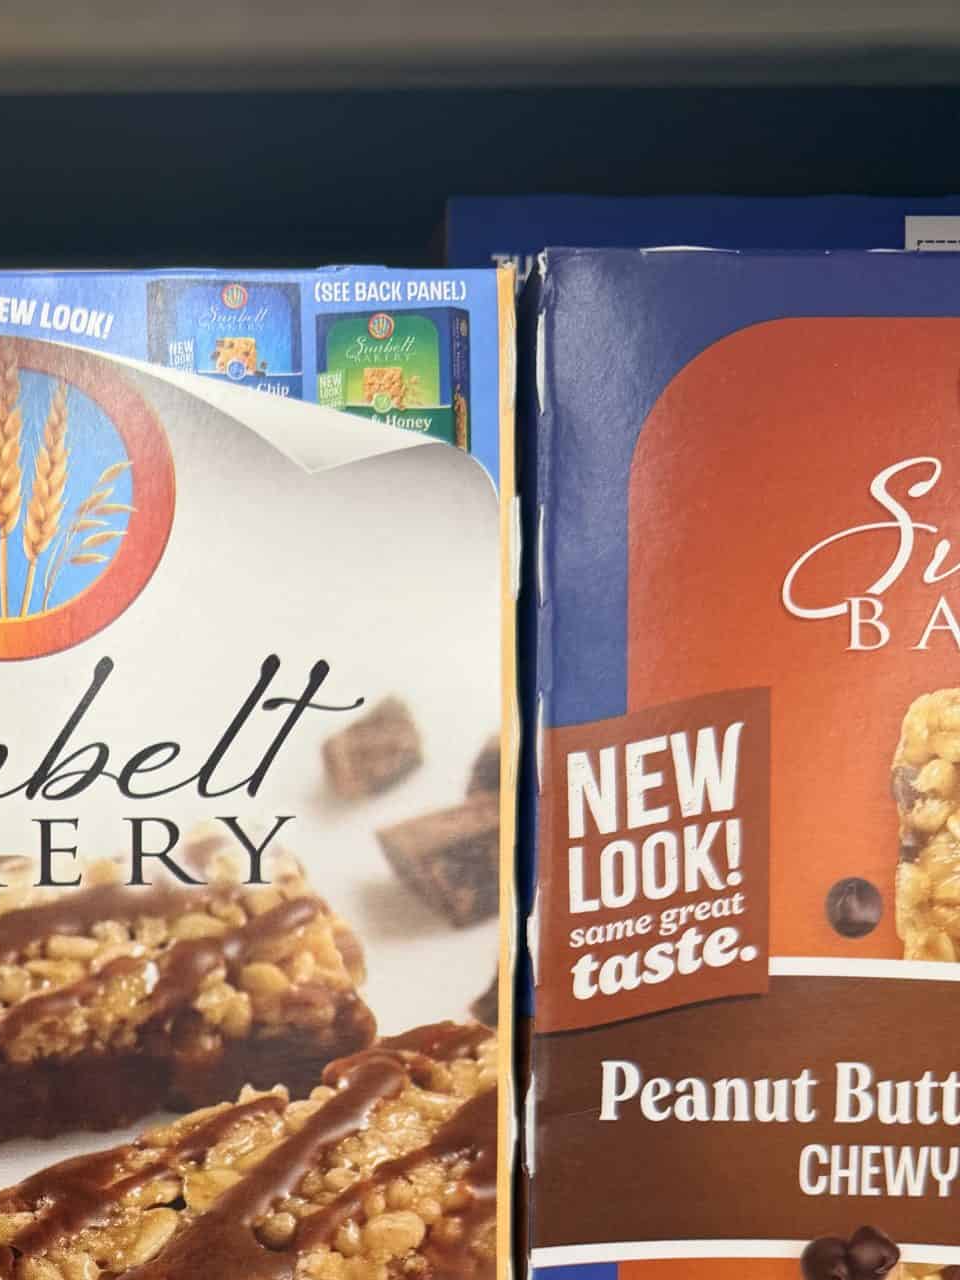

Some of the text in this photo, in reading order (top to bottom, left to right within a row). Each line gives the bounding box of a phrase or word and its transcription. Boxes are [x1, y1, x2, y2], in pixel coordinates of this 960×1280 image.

[314, 280, 467, 302] (SEE BACK PANEL)
[41, 304, 113, 339] LOOK!
[566, 721, 745, 839] NEW
[568, 818, 742, 914] LOOK!
[569, 891, 746, 948] same great
[570, 926, 759, 1001] taste.
[598, 1060, 820, 1124] Peanut
[798, 1143, 960, 1198] CHEWY
